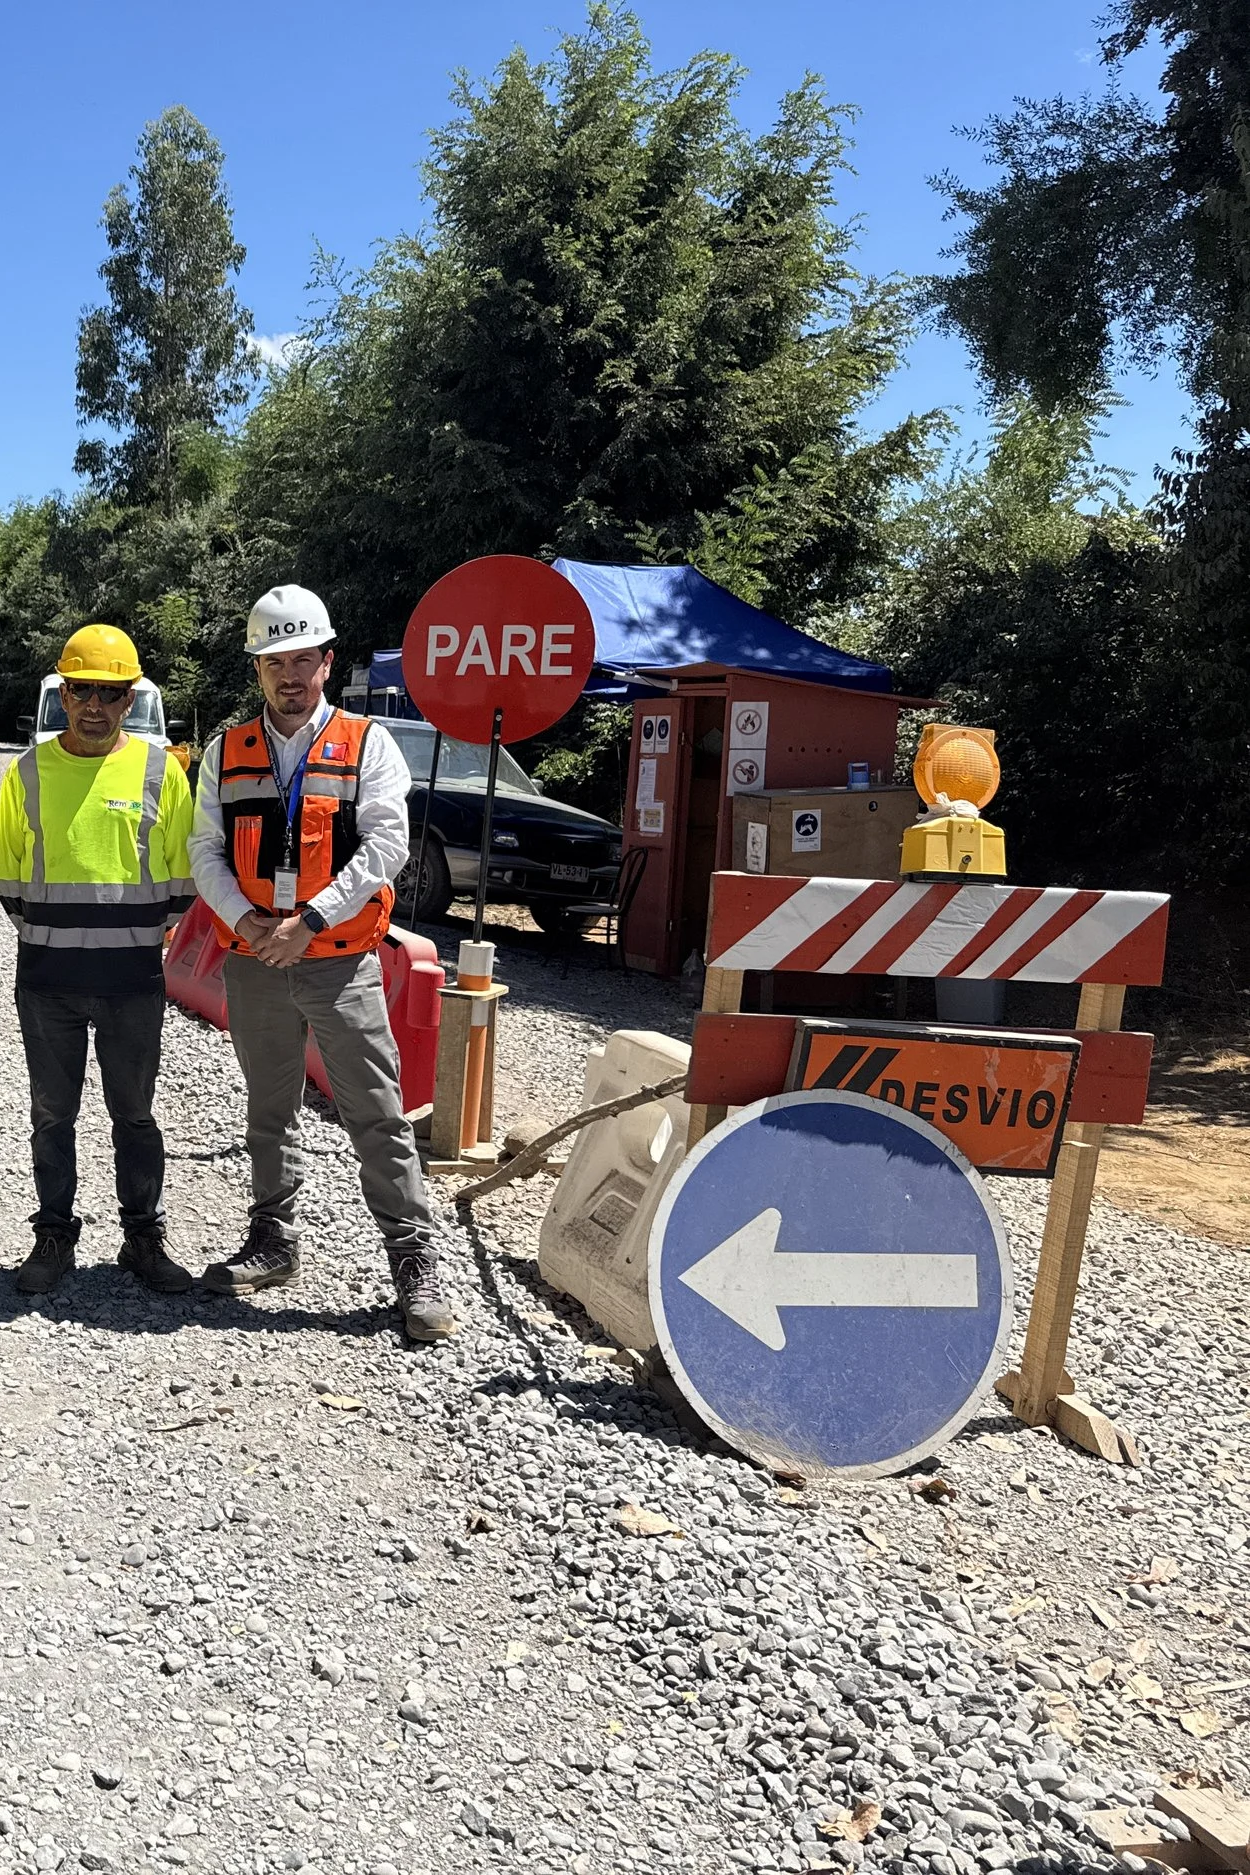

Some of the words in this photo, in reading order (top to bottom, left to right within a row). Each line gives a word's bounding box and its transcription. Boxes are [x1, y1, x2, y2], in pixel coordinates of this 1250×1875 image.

[268, 620, 308, 638] MOP
[425, 624, 576, 677] PARE
[878, 1078, 1056, 1130] DESVIO
